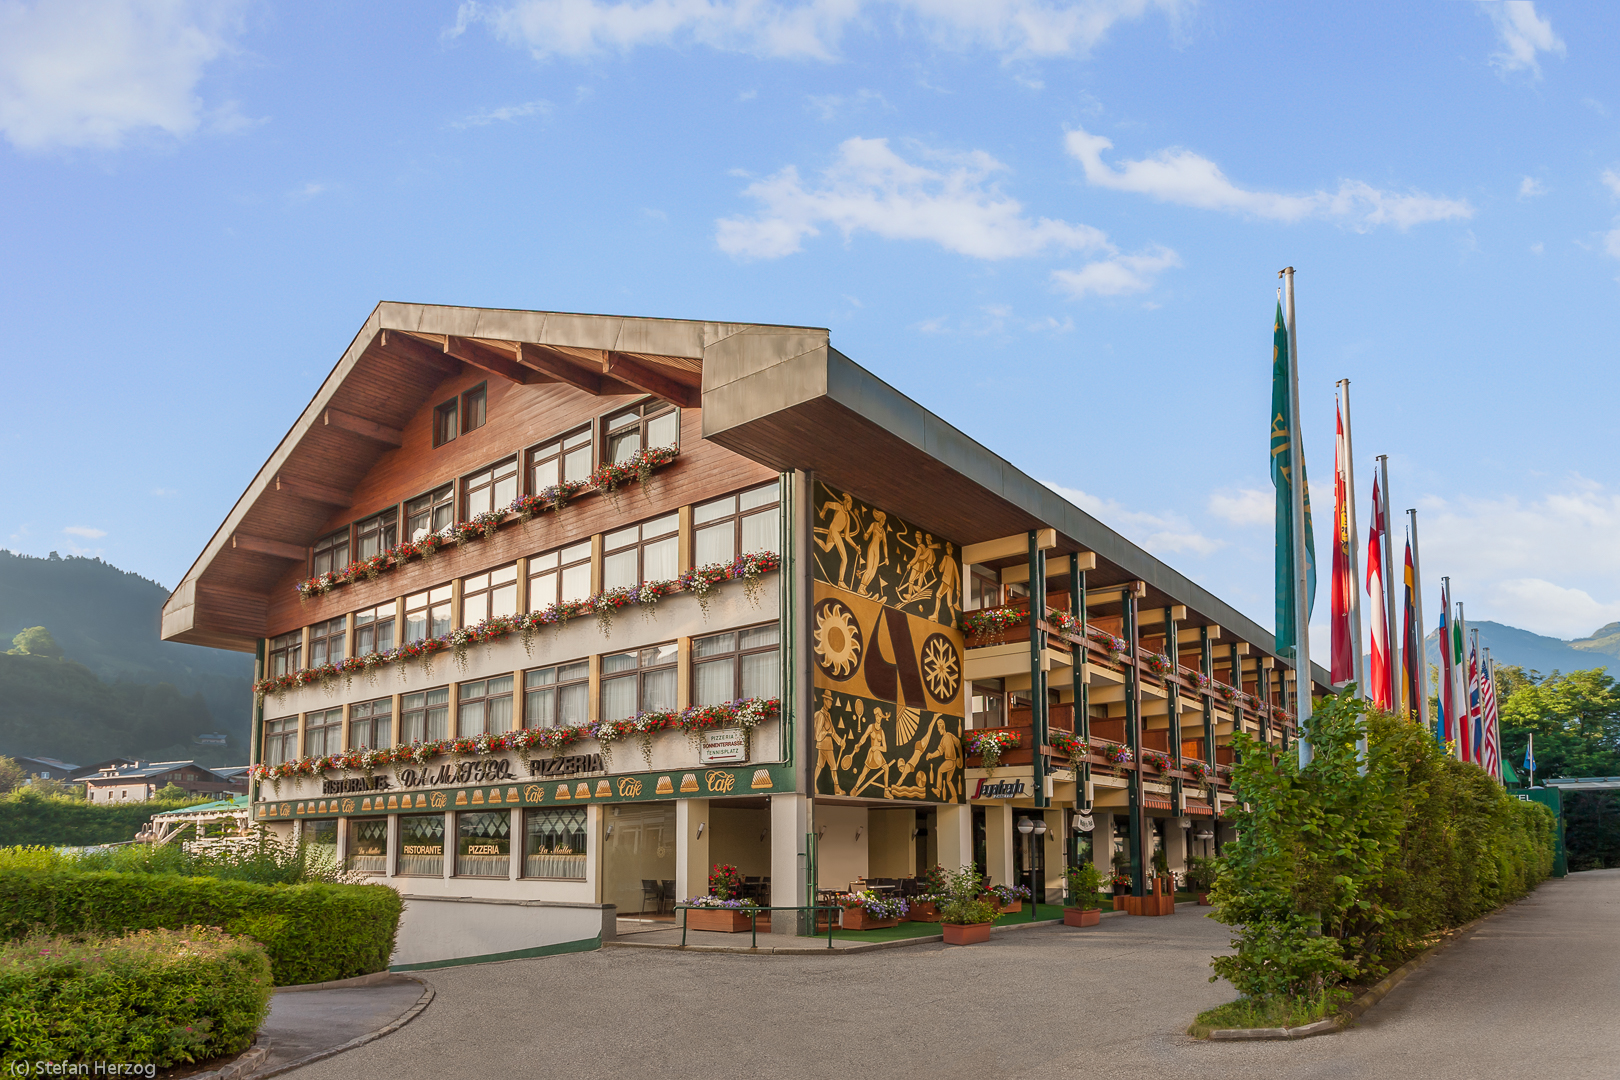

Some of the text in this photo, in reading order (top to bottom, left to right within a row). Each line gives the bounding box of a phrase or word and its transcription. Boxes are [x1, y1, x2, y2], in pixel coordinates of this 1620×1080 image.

[702, 740, 743, 749] SONNENTERRASSE
[530, 753, 604, 777] PIZZERIA
[403, 845, 442, 855] RISTORANTE
[468, 845, 500, 855] PIZZERIA
